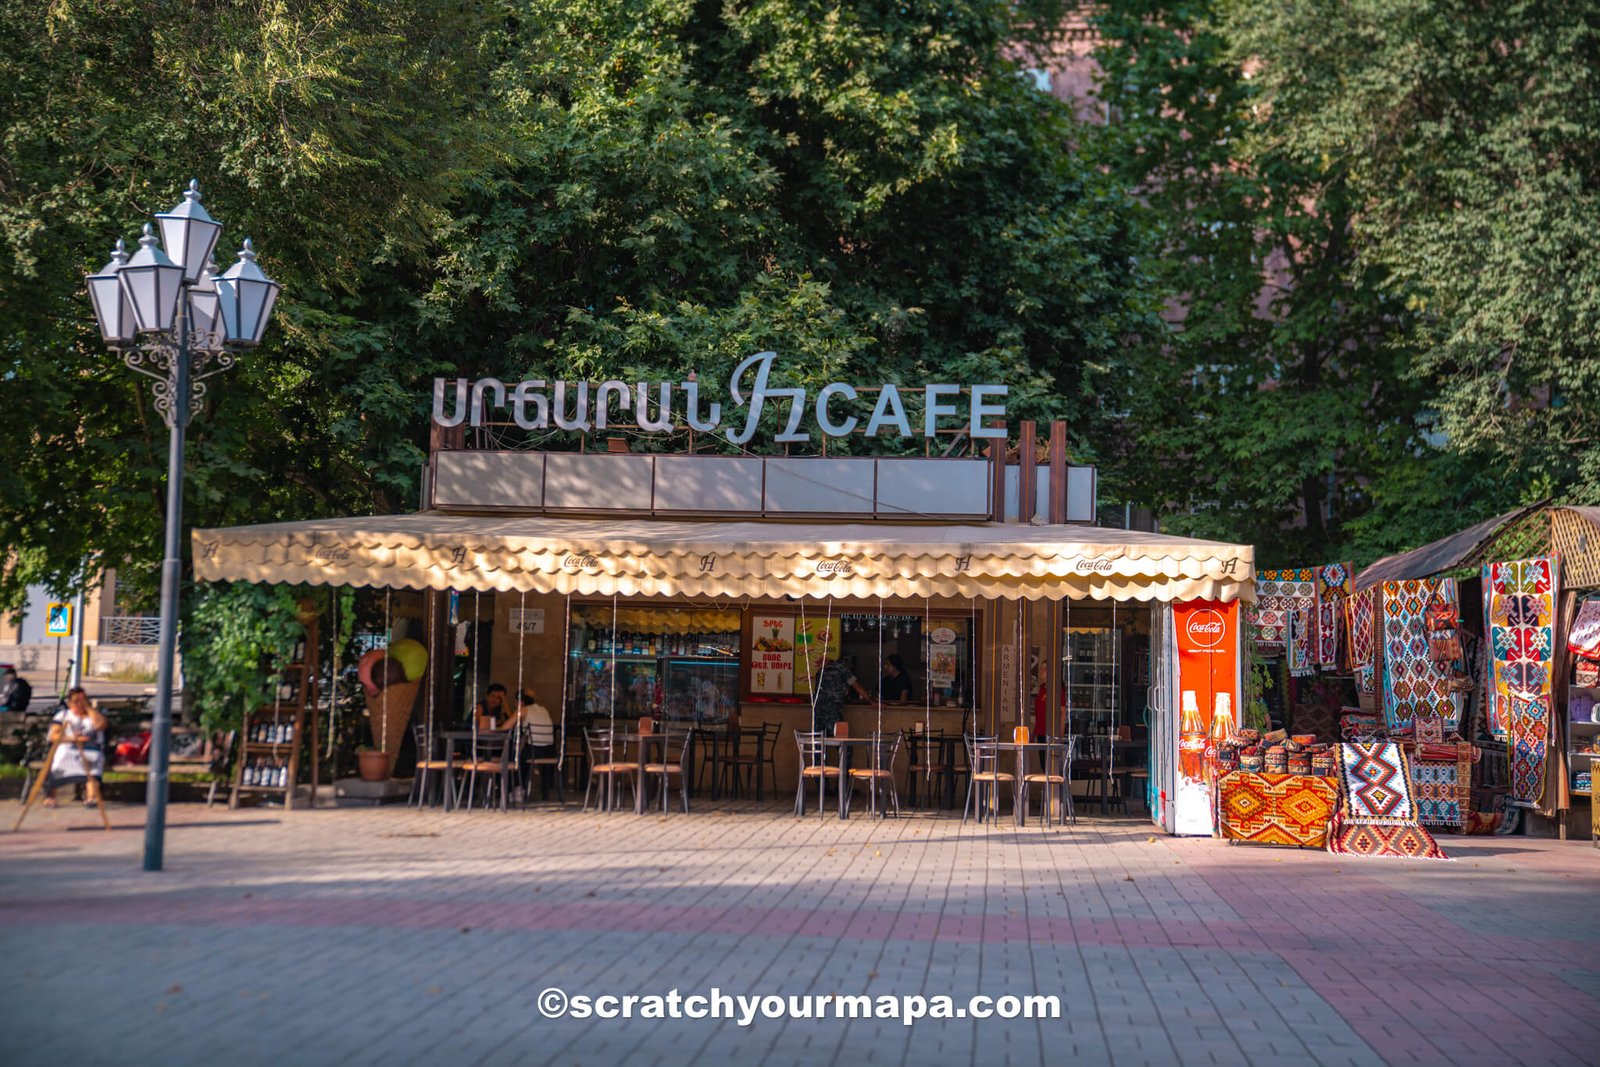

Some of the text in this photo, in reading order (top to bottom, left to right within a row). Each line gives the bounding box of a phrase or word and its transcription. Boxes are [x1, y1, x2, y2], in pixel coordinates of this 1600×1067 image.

[432, 376, 721, 433] ՍՐՃԱՐԱՆ
[816, 382, 1009, 441] CAFE
[1002, 646, 1010, 712] ARMENIAN
